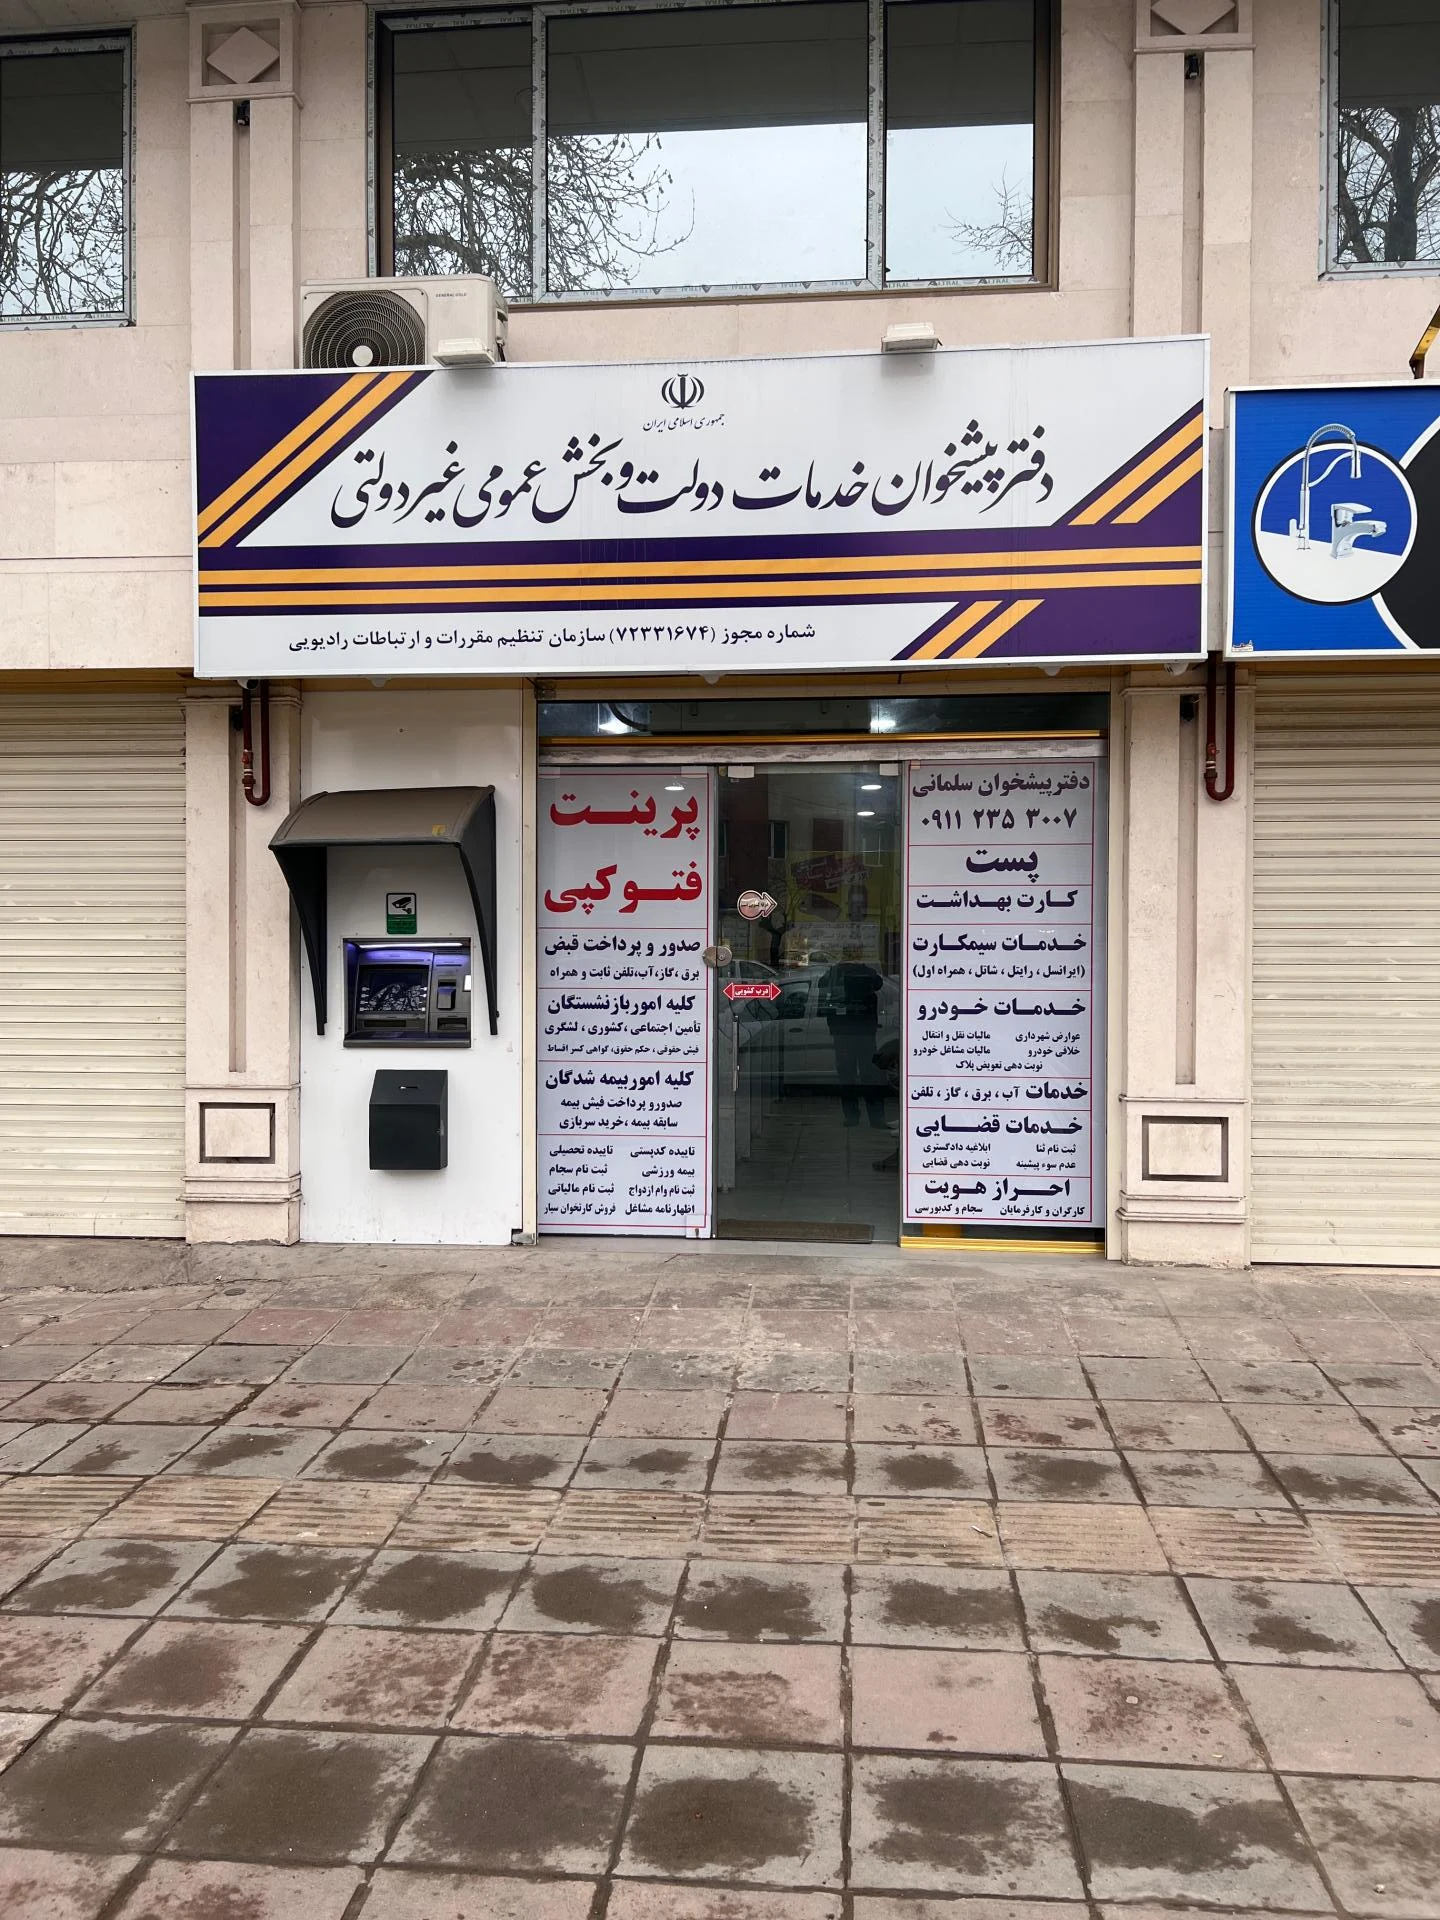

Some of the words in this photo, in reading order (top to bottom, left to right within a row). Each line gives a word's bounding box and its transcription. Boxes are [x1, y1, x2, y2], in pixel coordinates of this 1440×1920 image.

[643, 418, 666, 433] ایران
[667, 417, 693, 430] اسلامی
[694, 414, 725, 429] جمهوری
[871, 419, 1005, 516] پیشخوان
[979, 424, 1053, 514] دفتر
[532, 433, 624, 523] بخش
[615, 461, 634, 490] و
[617, 457, 724, 513] دولت
[733, 460, 869, 510] خدمات
[452, 460, 547, 528] عمومی
[352, 630, 420, 649] ارتباطات
[436, 630, 493, 649] مقررات
[497, 629, 544, 648] تنظیم
[549, 628, 605, 647] سازمان
[721, 627, 763, 644] مجوز
[766, 624, 816, 644] شماره
[289, 631, 349, 652] رادیویی
[425, 637, 432, 649] و
[912, 773, 973, 797] سلمانی
[550, 790, 701, 841] پرینت
[966, 849, 1039, 884] پست
[544, 861, 703, 916] فتوکپی
[916, 890, 1012, 912] بهداشت
[1017, 889, 1078, 913] کارت
[544, 934, 579, 956] قبض
[583, 935, 642, 957] پرداخت
[658, 938, 701, 957] صدور
[912, 933, 997, 957] سیمکارت
[1002, 933, 1087, 951] خدمات
[645, 942, 654, 957] و
[550, 967, 578, 981] همراه
[581, 971, 586, 981] و
[589, 967, 611, 980] ثابت
[937, 965, 965, 979] همراه
[975, 965, 998, 978] شاتل
[1007, 965, 1033, 978] رایتل
[666, 995, 696, 1015] کلیه
[917, 998, 988, 1020] خودرو
[994, 998, 1086, 1015] خدمات
[630, 1022, 672, 1035] اجتماعی
[967, 1030, 991, 1040] مالیات
[922, 1030, 943, 1041] انتقال
[952, 1031, 965, 1041] نقل
[1015, 1031, 1050, 1043] شهرداری
[1052, 1031, 1081, 1043] عوارض
[913, 1046, 938, 1057] خودرو
[940, 1045, 965, 1056] مشاغل
[967, 1045, 991, 1055] مالیات
[1028, 1046, 1053, 1058] خودرو
[1055, 1046, 1080, 1058] خلافی
[956, 1060, 974, 1072] پلاک
[976, 1060, 1002, 1072] تعویض
[1004, 1062, 1022, 1072] دهی
[1024, 1061, 1043, 1072] نوبت
[545, 1069, 595, 1090] شدگان
[665, 1070, 694, 1090] کلیه
[911, 1087, 934, 1100] تلفن
[944, 1087, 961, 1100] گاز
[972, 1089, 991, 1101] برق
[1002, 1086, 1020, 1101] آب
[1026, 1081, 1088, 1099] خدمات
[560, 1098, 580, 1110] بیمه
[582, 1096, 604, 1110] فیش
[607, 1097, 646, 1112] پرداخت
[559, 1116, 596, 1130] سربازی
[631, 1118, 650, 1130] بیمه
[653, 1116, 678, 1130] سابقه
[916, 1114, 1000, 1137] قضایی
[1006, 1116, 1082, 1134] خدمات
[549, 1144, 585, 1157] تحصیلی
[923, 1142, 963, 1153] دادگستری
[966, 1143, 991, 1154] ابلاغیه
[1036, 1144, 1045, 1152] ثنا
[1048, 1144, 1059, 1155] نام
[1061, 1144, 1076, 1155] ثبت
[922, 1157, 948, 1168] قضایی
[950, 1159, 968, 1169] دهی
[971, 1158, 990, 1169] نوبت
[549, 1163, 573, 1176] سجام
[575, 1164, 589, 1176] نام
[591, 1163, 608, 1176] ثبت
[642, 1165, 674, 1178] ورزشی
[677, 1167, 695, 1178] بیمه
[548, 1182, 580, 1196] مالیاتی
[582, 1183, 595, 1196] نام
[597, 1182, 615, 1196] ثبت
[628, 1184, 654, 1197] ازدواج
[655, 1184, 667, 1197] وام
[669, 1184, 680, 1197] نام
[681, 1184, 695, 1197] ثبت
[924, 1179, 987, 1200] هویت
[992, 1178, 1070, 1201] احراز
[543, 1202, 559, 1215] سیار
[560, 1202, 593, 1215] کارتخوان
[594, 1202, 616, 1215] فروش
[625, 1203, 653, 1216] مشاغل
[962, 1204, 983, 1214] سجام
[1000, 1205, 1043, 1217] کارفرمایان
[1052, 1206, 1085, 1217] کارگران
